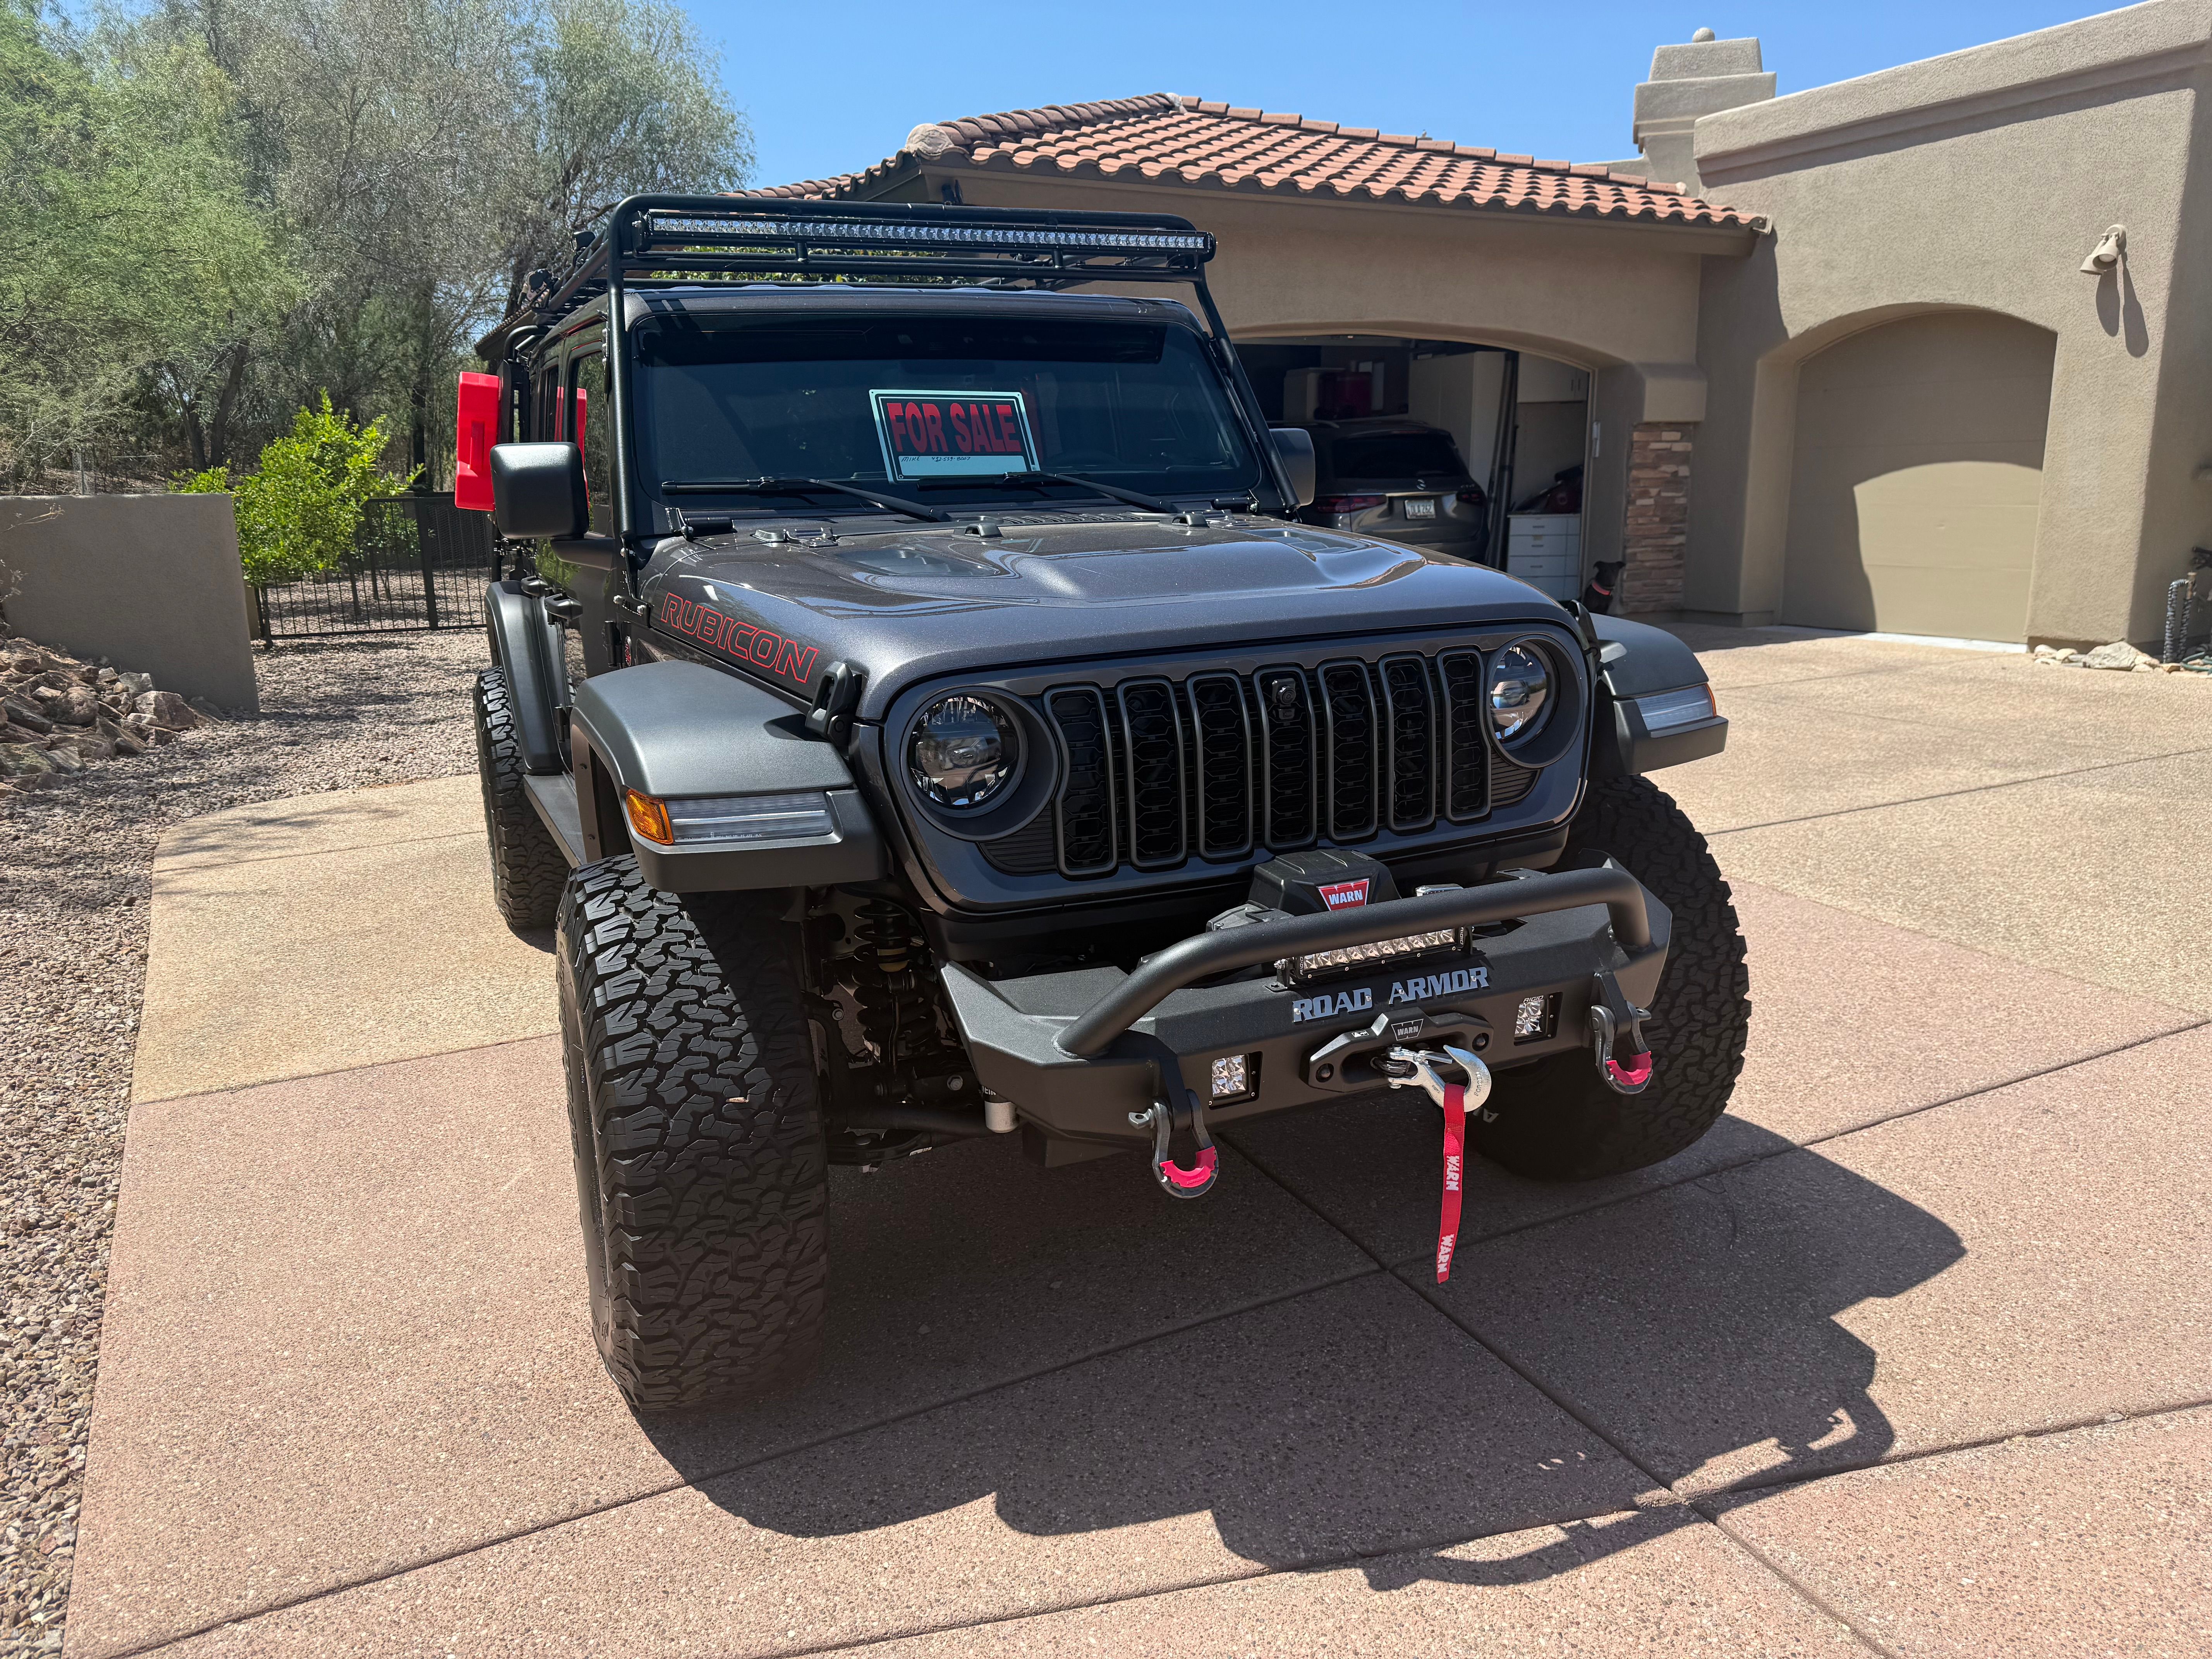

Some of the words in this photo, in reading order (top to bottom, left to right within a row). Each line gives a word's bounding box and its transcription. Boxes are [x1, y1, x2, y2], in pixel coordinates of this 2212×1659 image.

[886, 402, 948, 453] FOR
[950, 403, 1022, 453] SALE
[661, 592, 819, 684] RUBICON
[1328, 889, 1363, 905] WARN
[1291, 988, 1373, 1023] ROAD
[1388, 967, 1489, 1005] ARMOR
[1523, 995, 1544, 1003] RIGID
[1397, 1025, 1419, 1036] WARN
[1446, 1155, 1460, 1191] WARN
[1437, 1234, 1455, 1273] WARN
